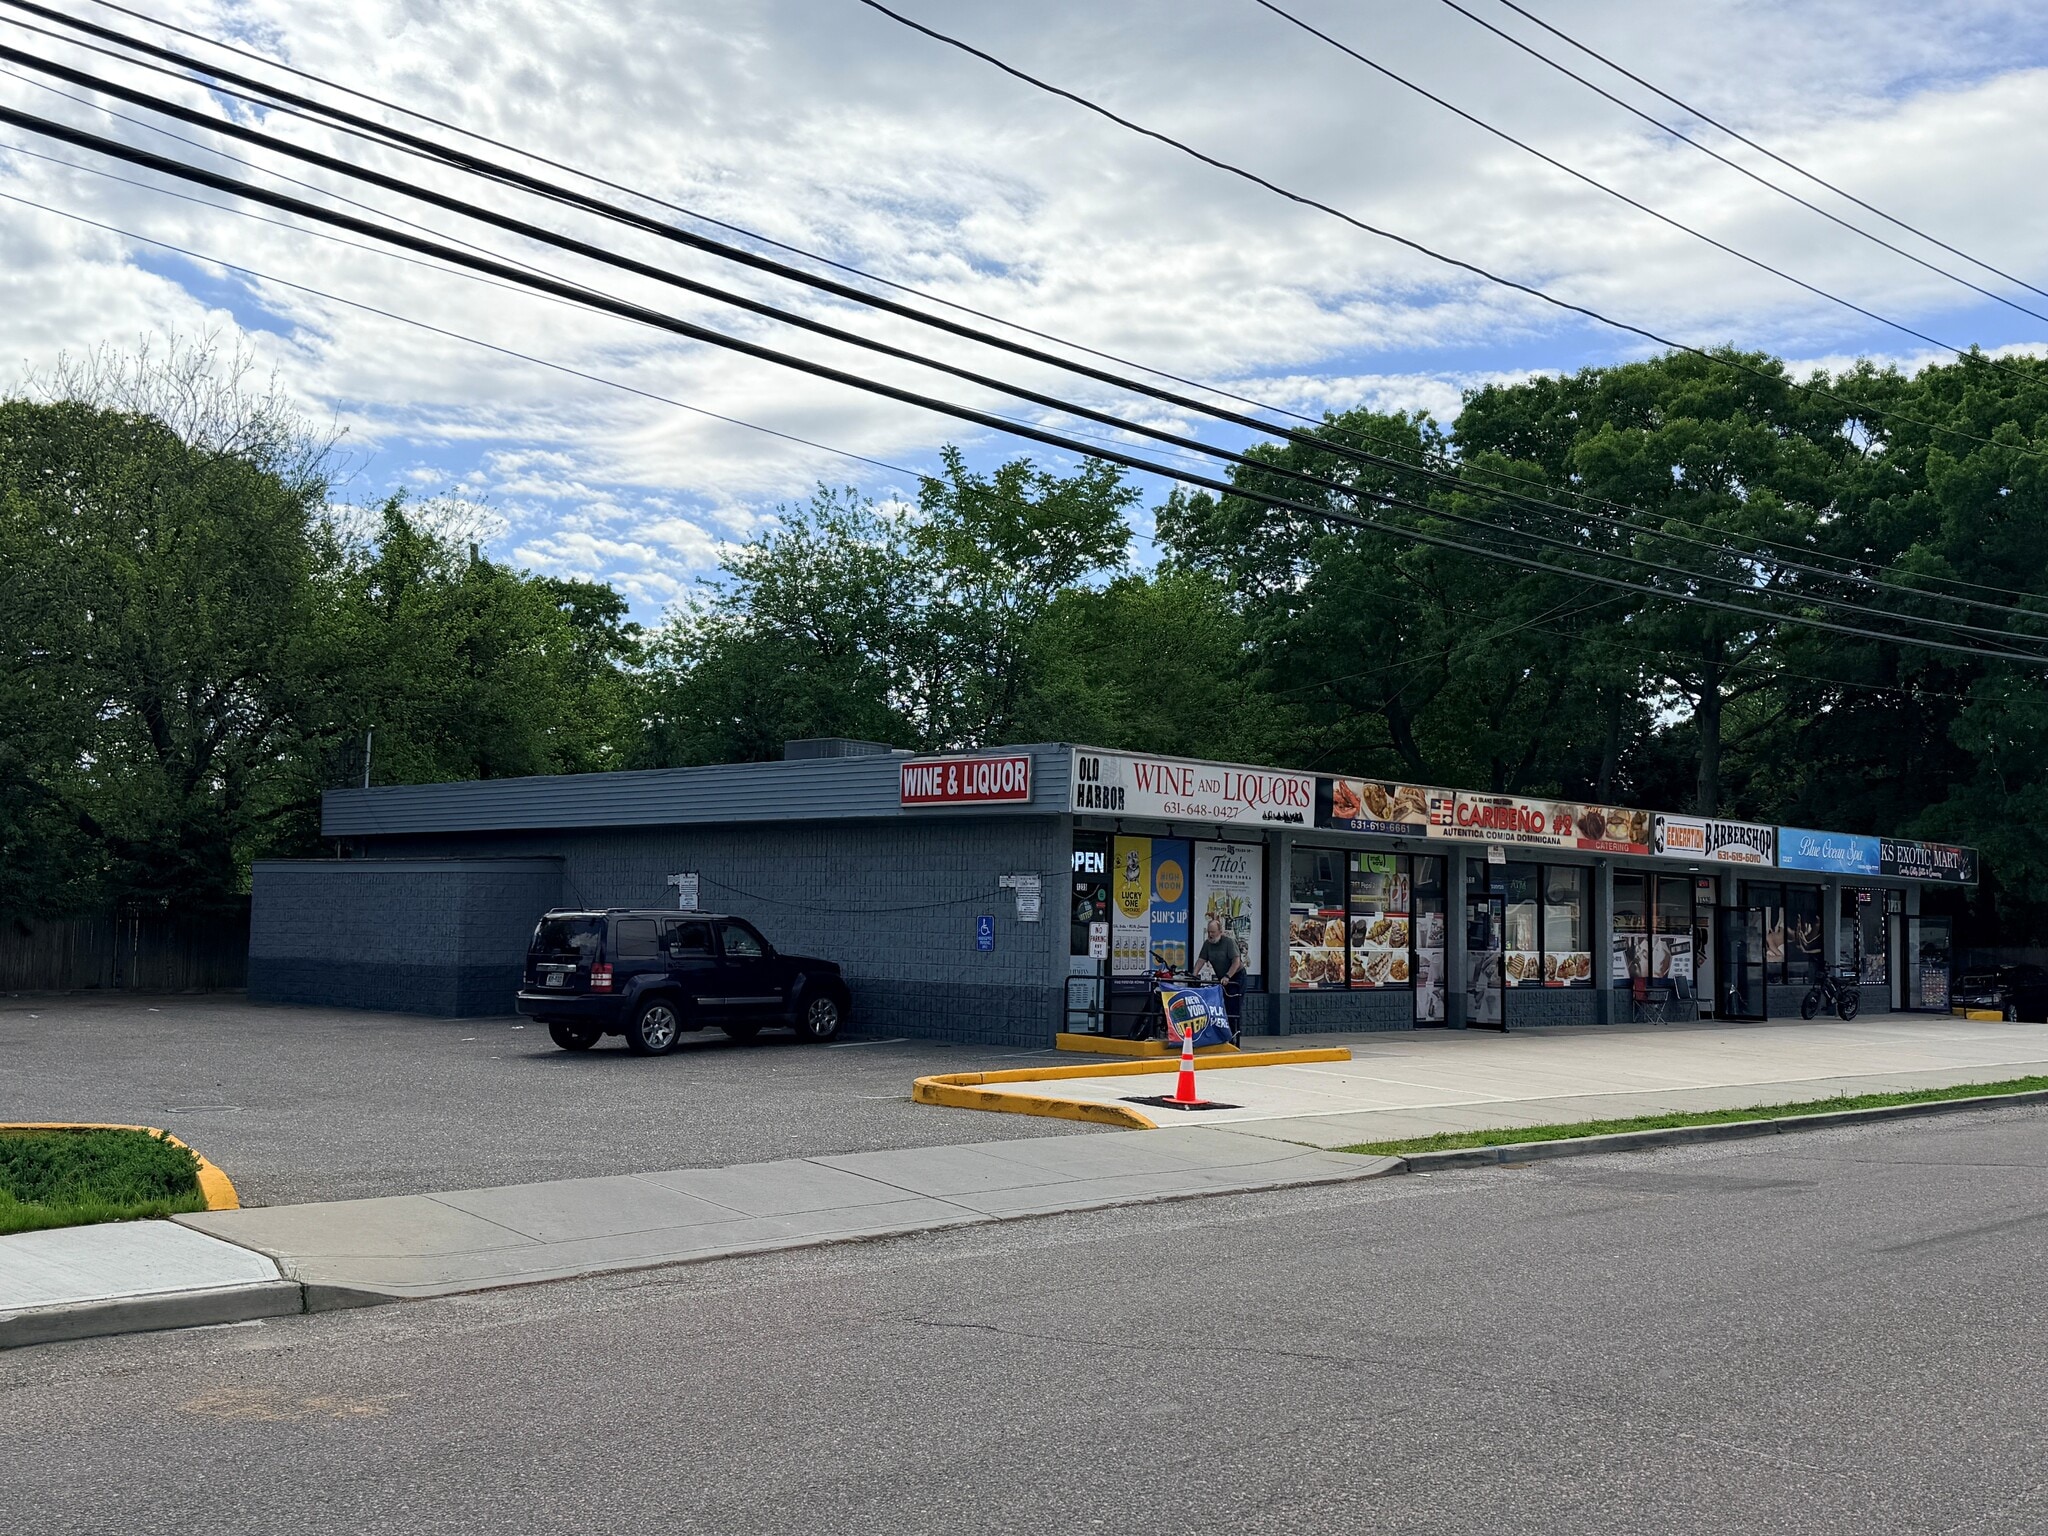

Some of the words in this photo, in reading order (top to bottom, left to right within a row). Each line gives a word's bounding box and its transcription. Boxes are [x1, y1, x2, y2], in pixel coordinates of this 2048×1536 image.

[1079, 756, 1099, 782] OLD
[904, 766, 943, 797] WINE
[947, 765, 958, 795] &
[963, 761, 1026, 796] LIQUOR
[1133, 763, 1195, 797] WINE
[1198, 779, 1221, 794] AND
[1223, 772, 1311, 810] LIQUORS
[1076, 783, 1125, 811] HARBOR
[1164, 801, 1239, 819] 631-648-0427
[1457, 802, 1546, 833] CARIBEÑO
[1552, 814, 1573, 836] #2
[1350, 819, 1410, 834] 631-619-6661
[1443, 827, 1485, 840] AUTENTICA
[1486, 831, 1515, 842] COMIDA
[1516, 834, 1561, 846] DOMINICANA
[1666, 826, 1704, 849] GENERATION
[1704, 822, 1772, 861] BARBERSHOP
[1595, 842, 1630, 853] CATERING
[1798, 835, 1820, 858] Blue
[1822, 838, 1845, 860] Ocean
[1846, 837, 1864, 866] Spa
[1881, 843, 1895, 862] KS
[1896, 846, 1931, 866] EXOTIC
[1934, 850, 1959, 869] MART
[1211, 854, 1247, 873] Tito's
[1121, 891, 1142, 900] LUCKY
[1125, 899, 1139, 908] ONE
[1151, 909, 1175, 923] SUN'S
[1176, 911, 1188, 924] UP
[1094, 926, 1103, 934] NO
[1209, 1005, 1224, 1016] PLA
